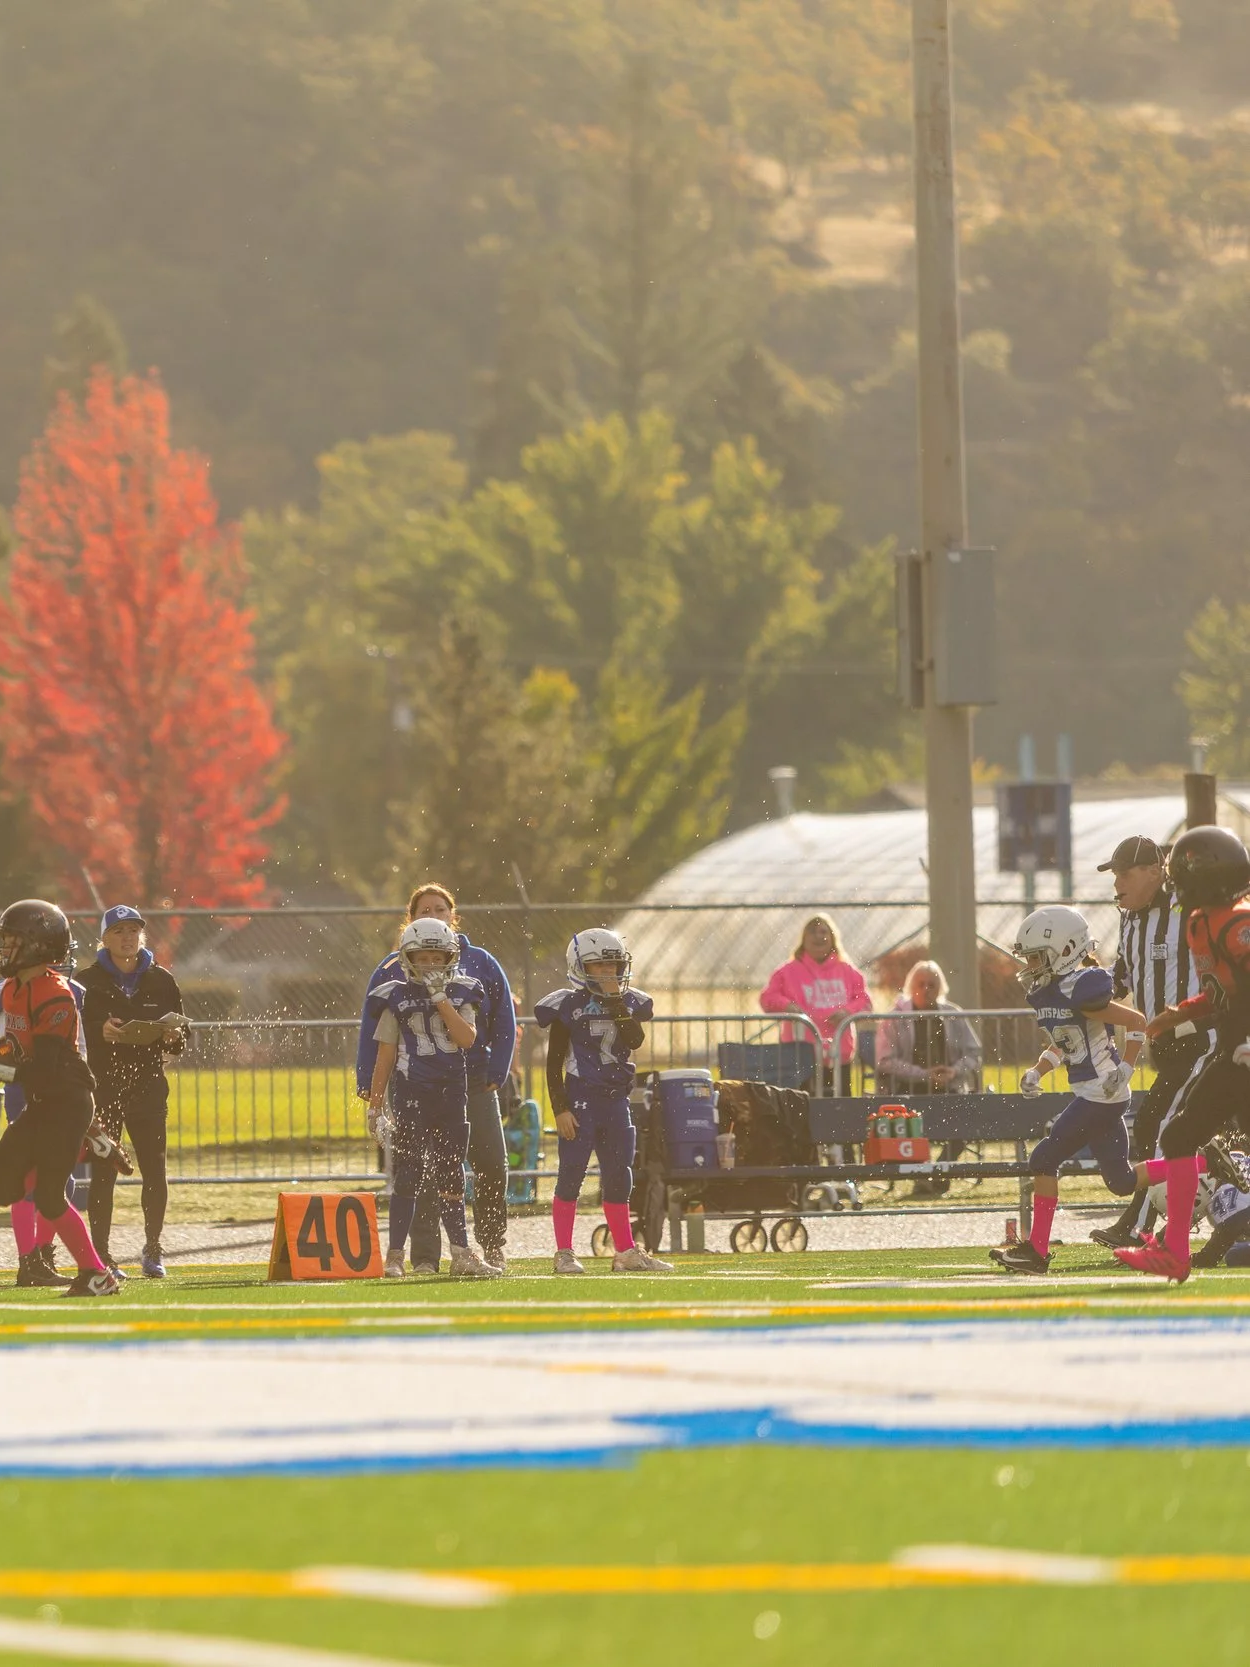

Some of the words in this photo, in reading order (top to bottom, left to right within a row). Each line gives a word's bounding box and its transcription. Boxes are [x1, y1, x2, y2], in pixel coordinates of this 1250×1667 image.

[407, 1011, 460, 1057] 10
[589, 1019, 619, 1065] 7
[1040, 1024, 1088, 1066] 3
[877, 1123, 888, 1135] G
[895, 1123, 906, 1135] G
[899, 1140, 914, 1158] G
[1212, 1186, 1239, 1218] 47
[296, 1195, 372, 1273] 40
